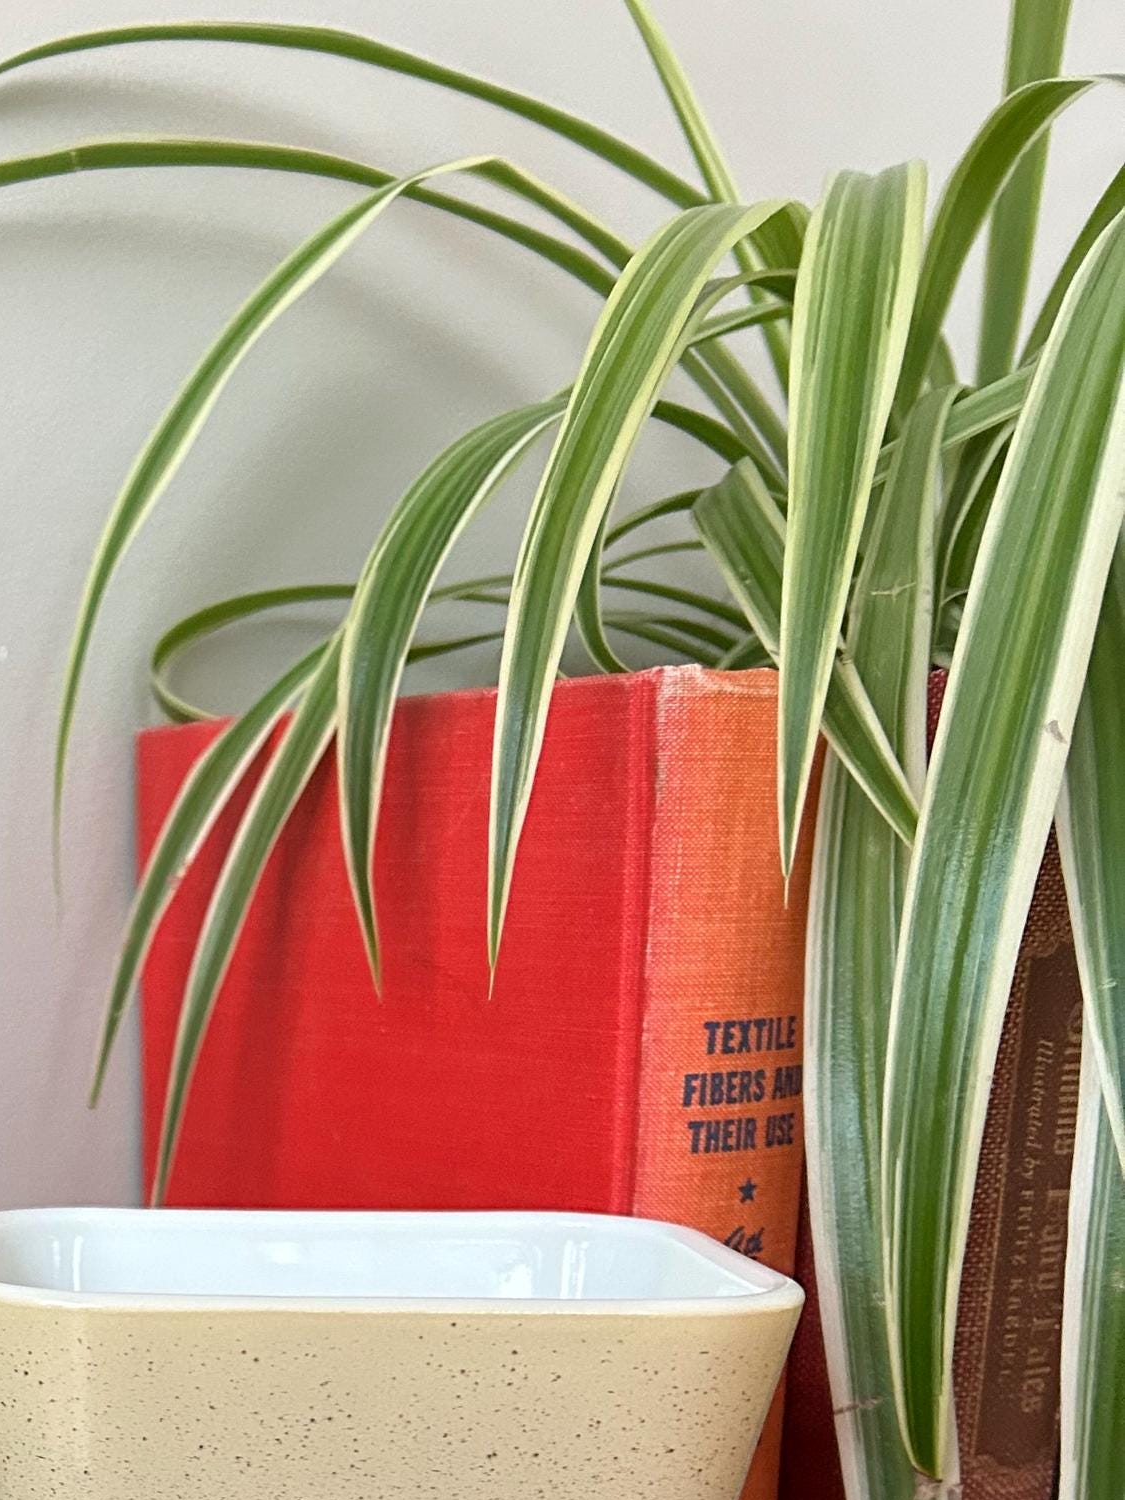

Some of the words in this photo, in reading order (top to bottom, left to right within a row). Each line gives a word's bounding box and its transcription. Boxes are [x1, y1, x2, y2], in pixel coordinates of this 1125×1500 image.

[702, 1015, 797, 1055] TEXTILE
[681, 1069, 766, 1108] FIBERS
[772, 1064, 803, 1100] AND
[1025, 1039, 1054, 1150] Illustrated
[687, 1117, 757, 1154] THEIR
[764, 1112, 796, 1148] USE
[1022, 1153, 1041, 1182] by
